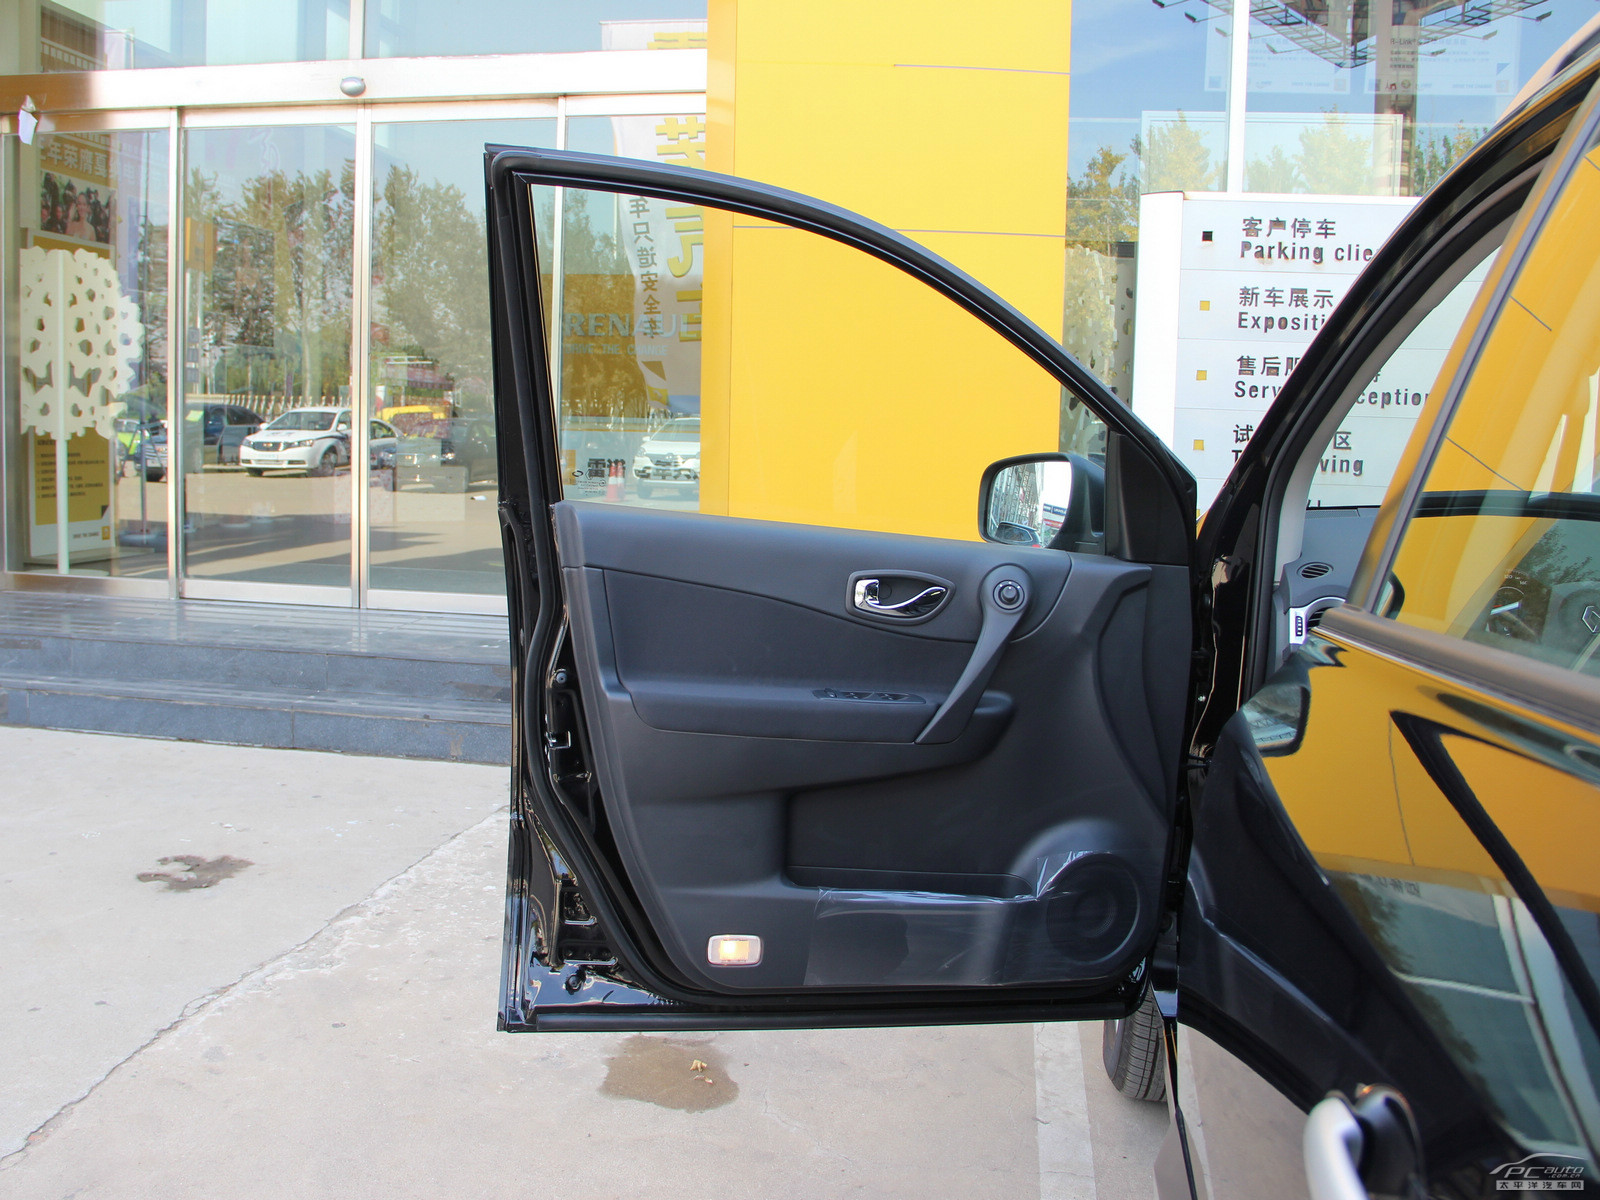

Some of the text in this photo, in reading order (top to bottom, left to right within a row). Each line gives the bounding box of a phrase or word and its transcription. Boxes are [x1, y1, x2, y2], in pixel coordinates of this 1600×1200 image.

[1241, 216, 1337, 239] 客户停车
[1239, 240, 1379, 265] Parking clie
[1238, 286, 1334, 309] 新车展示
[1332, 431, 1352, 450] 区
